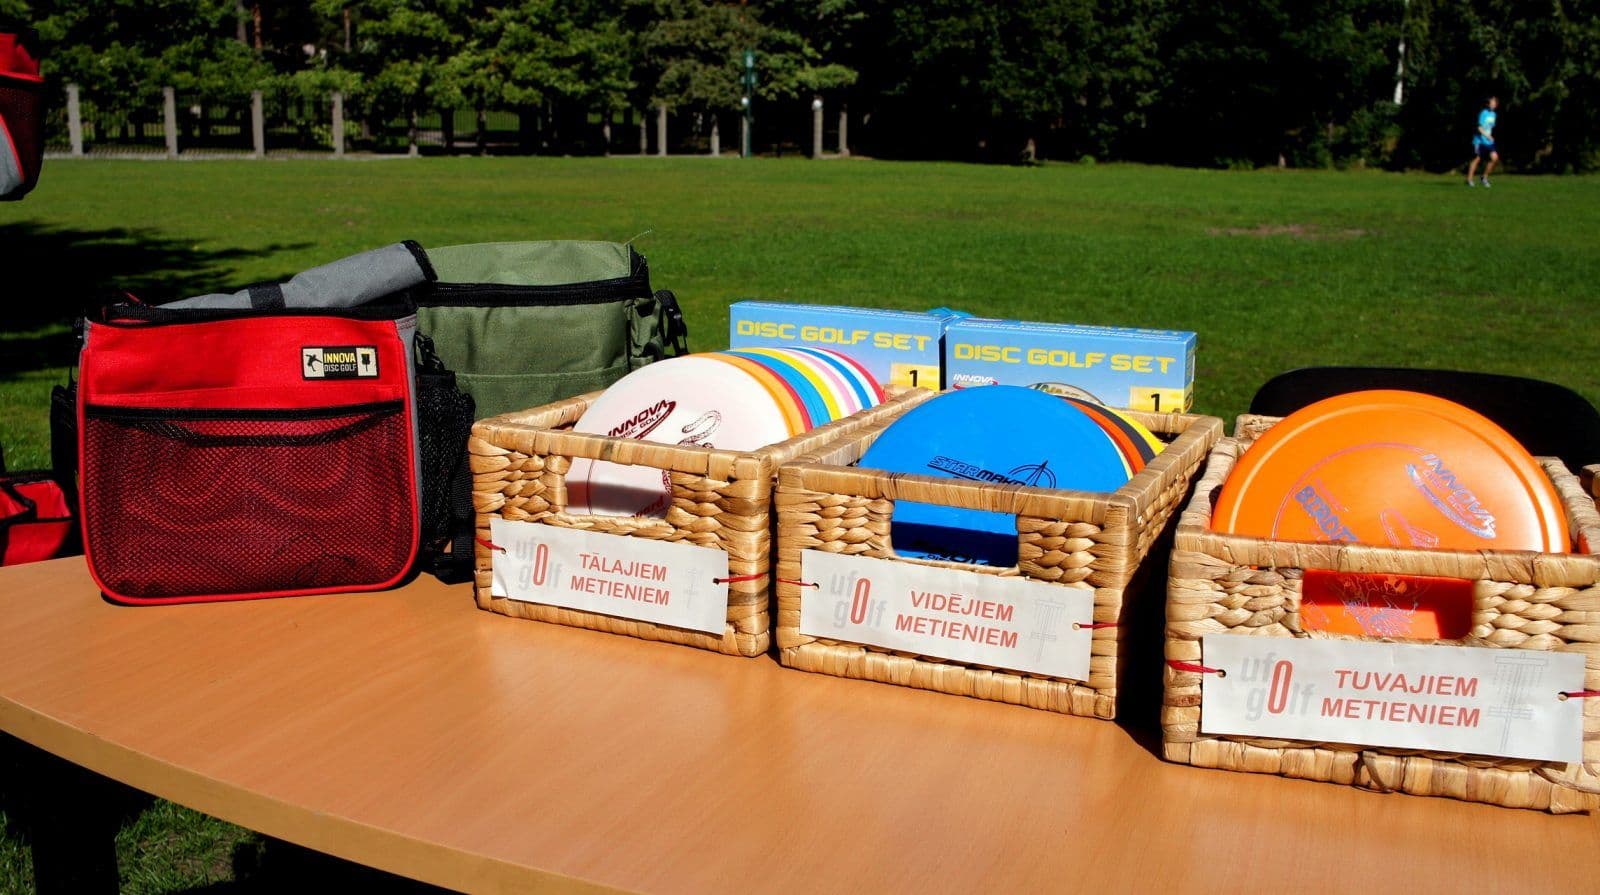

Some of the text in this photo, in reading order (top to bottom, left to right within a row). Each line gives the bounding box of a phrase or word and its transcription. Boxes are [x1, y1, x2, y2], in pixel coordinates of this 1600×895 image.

[737, 320, 932, 351] DISC GOLF SET
[324, 352, 356, 363] INNOVA
[324, 364, 357, 372] DISC GOLF
[954, 343, 1021, 363] DISC
[1027, 348, 1106, 368] GOLF
[1110, 354, 1176, 374] SET
[953, 373, 993, 384] INNOVA
[608, 399, 667, 437] INNOVA
[1423, 453, 1495, 529] INNOVA
[579, 551, 667, 582] TĀLAJIEM
[570, 575, 670, 606] METIENIEM
[911, 590, 1013, 622] VIDĒJIEM
[895, 614, 1018, 649] METIENIEM
[1334, 669, 1479, 697] TUVAJIEM
[1321, 697, 1480, 728] METIENIEM
